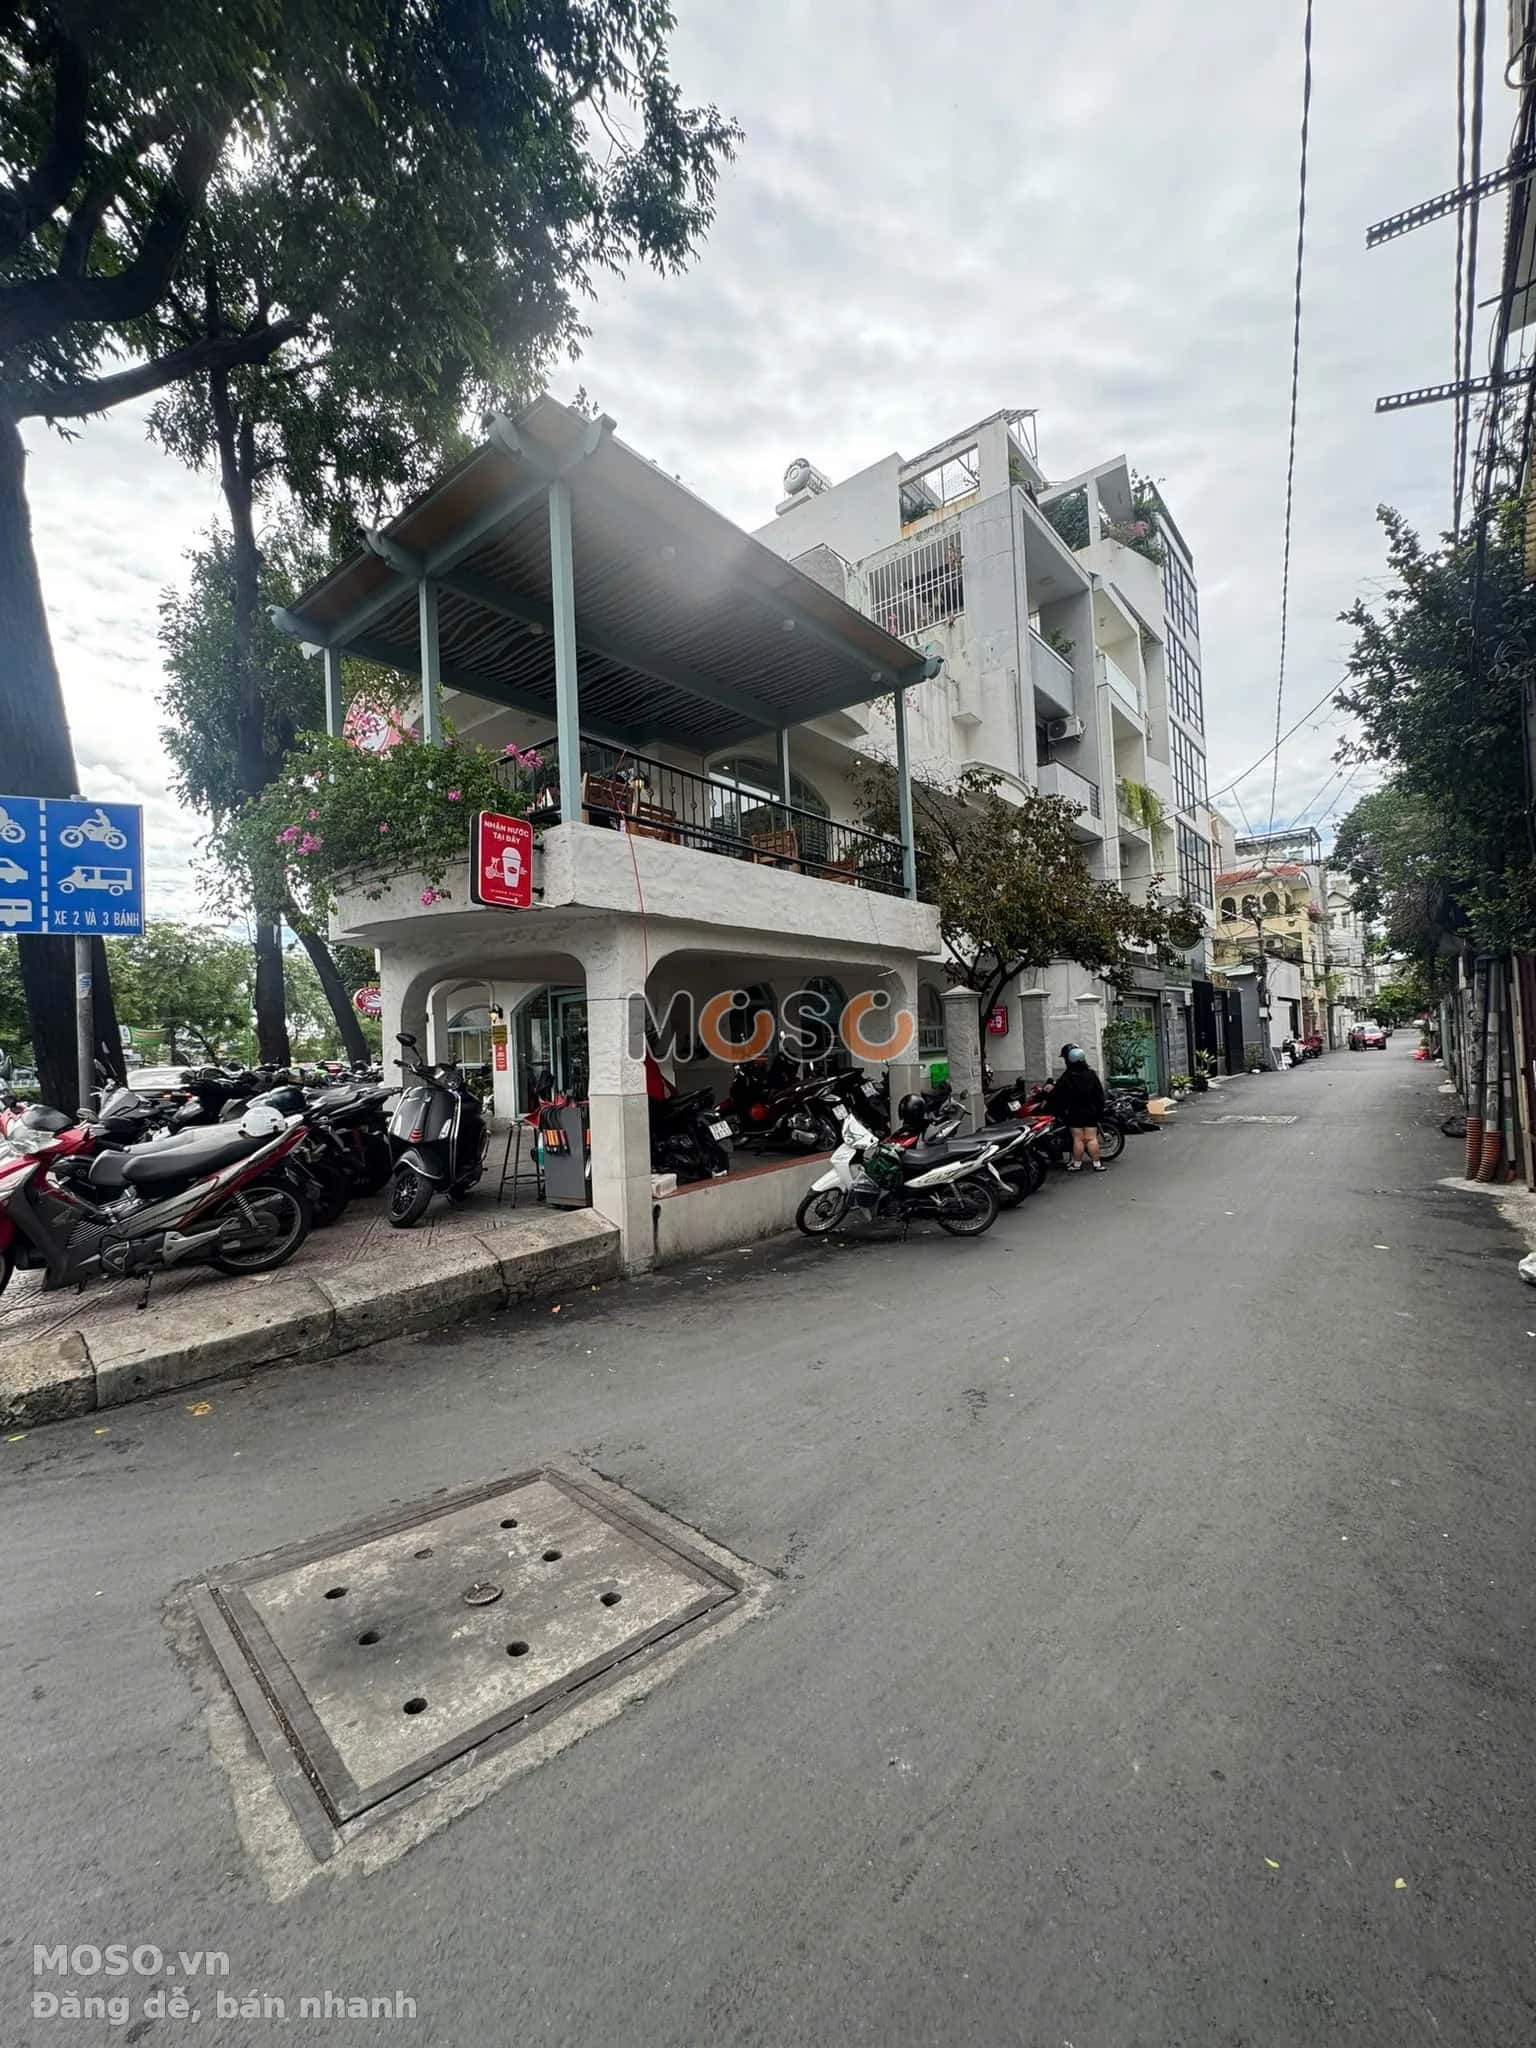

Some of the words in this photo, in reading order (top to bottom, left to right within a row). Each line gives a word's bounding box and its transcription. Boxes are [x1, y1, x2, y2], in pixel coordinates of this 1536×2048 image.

[54, 910, 68, 925] XE
[73, 911, 80, 926] 2
[85, 907, 97, 926] VÀ
[103, 911, 109, 926] 3
[113, 908, 139, 927] BÁNH
